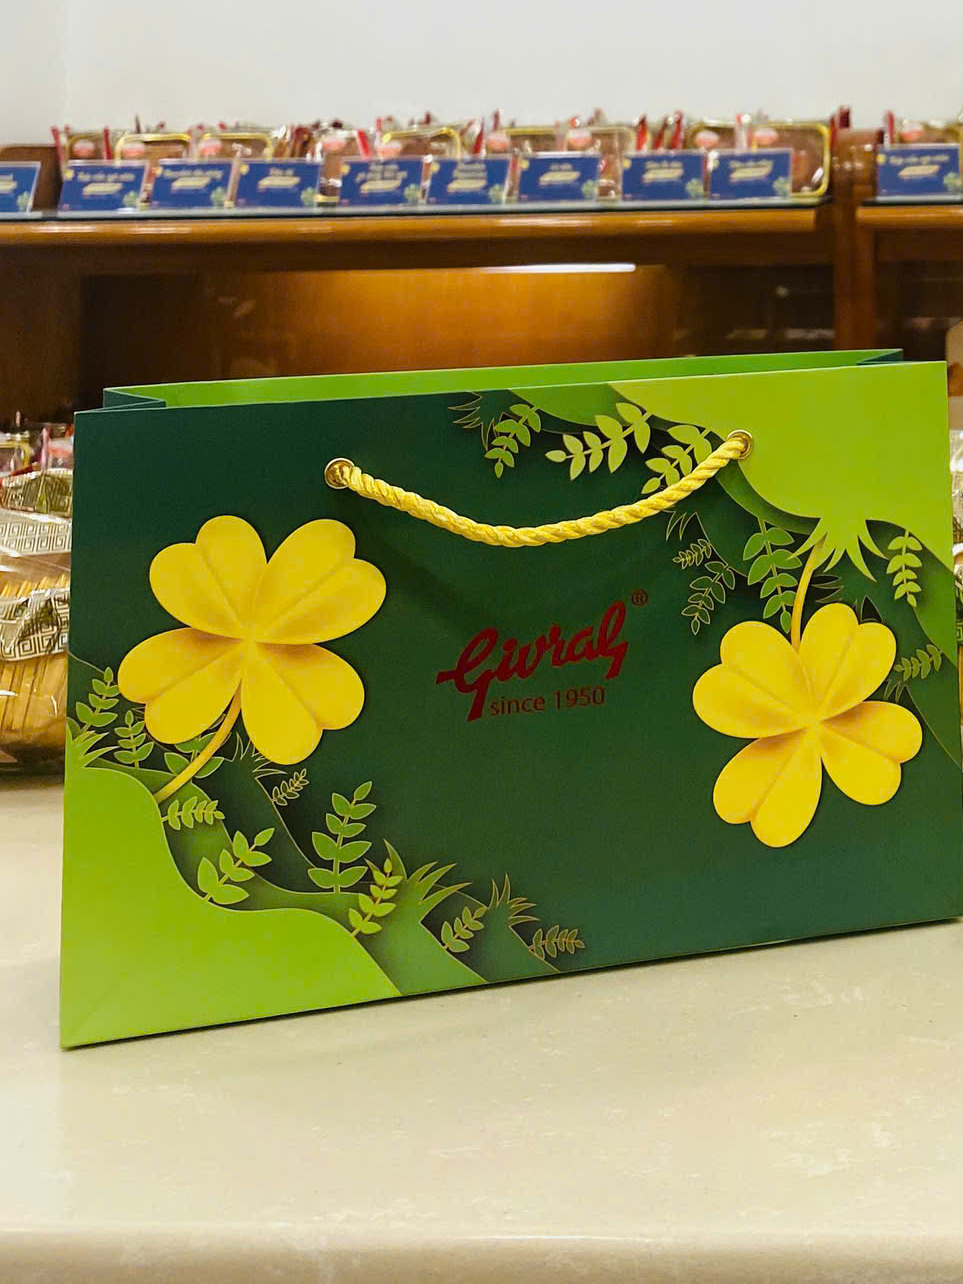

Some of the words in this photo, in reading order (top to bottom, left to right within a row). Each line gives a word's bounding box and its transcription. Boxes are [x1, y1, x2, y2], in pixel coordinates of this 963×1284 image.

[435, 600, 629, 723] Givral
[489, 695, 546, 717] since
[554, 686, 605, 709] 1950
